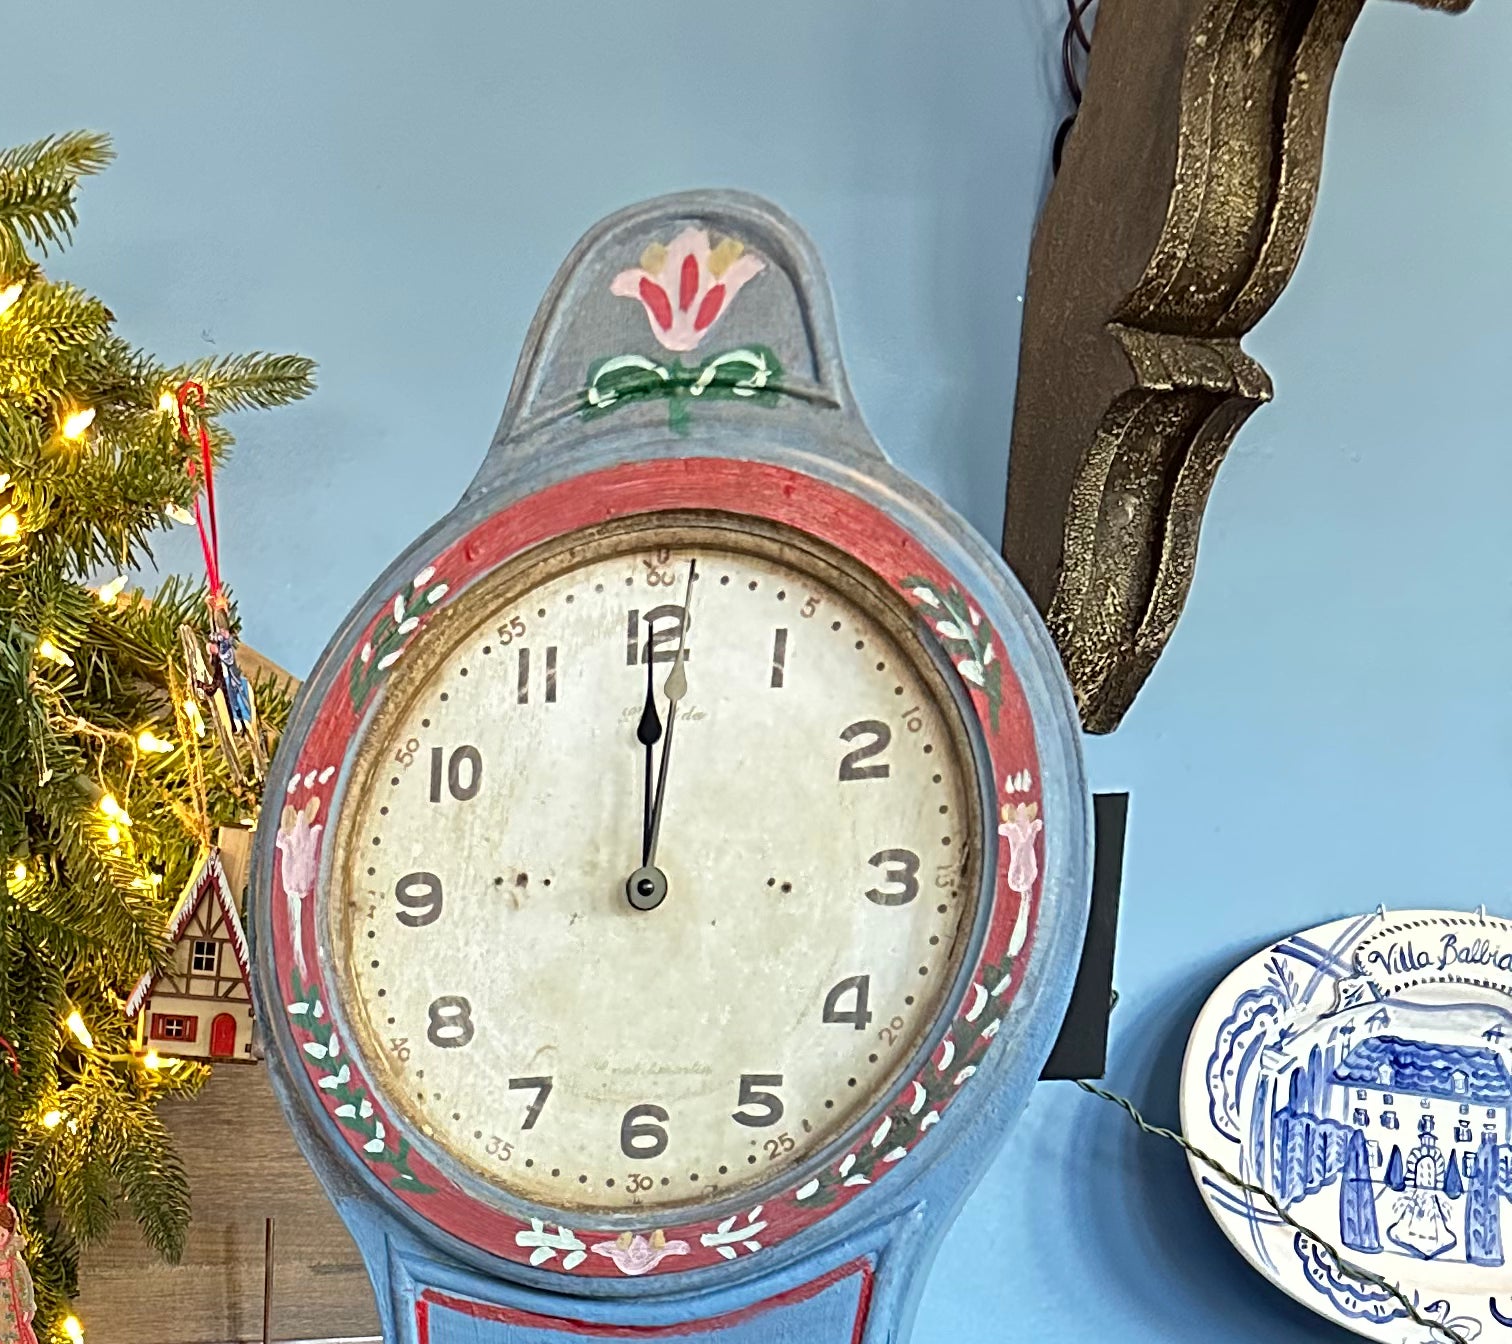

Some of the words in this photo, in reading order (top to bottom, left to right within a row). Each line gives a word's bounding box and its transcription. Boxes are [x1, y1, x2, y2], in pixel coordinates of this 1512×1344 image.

[497, 616, 526, 645] 55
[800, 596, 820, 618] 5
[627, 604, 692, 666] 12
[771, 628, 788, 688] 1
[517, 646, 557, 704] 11
[901, 706, 922, 732] 10
[395, 738, 419, 768] 50
[430, 745, 483, 803] 10
[839, 719, 892, 781] 2
[395, 872, 443, 927] 9
[864, 849, 920, 905] 3
[1368, 941, 1434, 975] Villa
[427, 996, 475, 1048] 8
[822, 974, 872, 1030] 4
[390, 1038, 410, 1062] 40
[878, 1016, 904, 1046] 20
[508, 1076, 553, 1130] 7
[731, 1074, 784, 1127] 5
[485, 1136, 515, 1161] 35
[620, 1104, 669, 1159] 6
[763, 1132, 795, 1160] 25
[626, 1174, 654, 1193] 30
